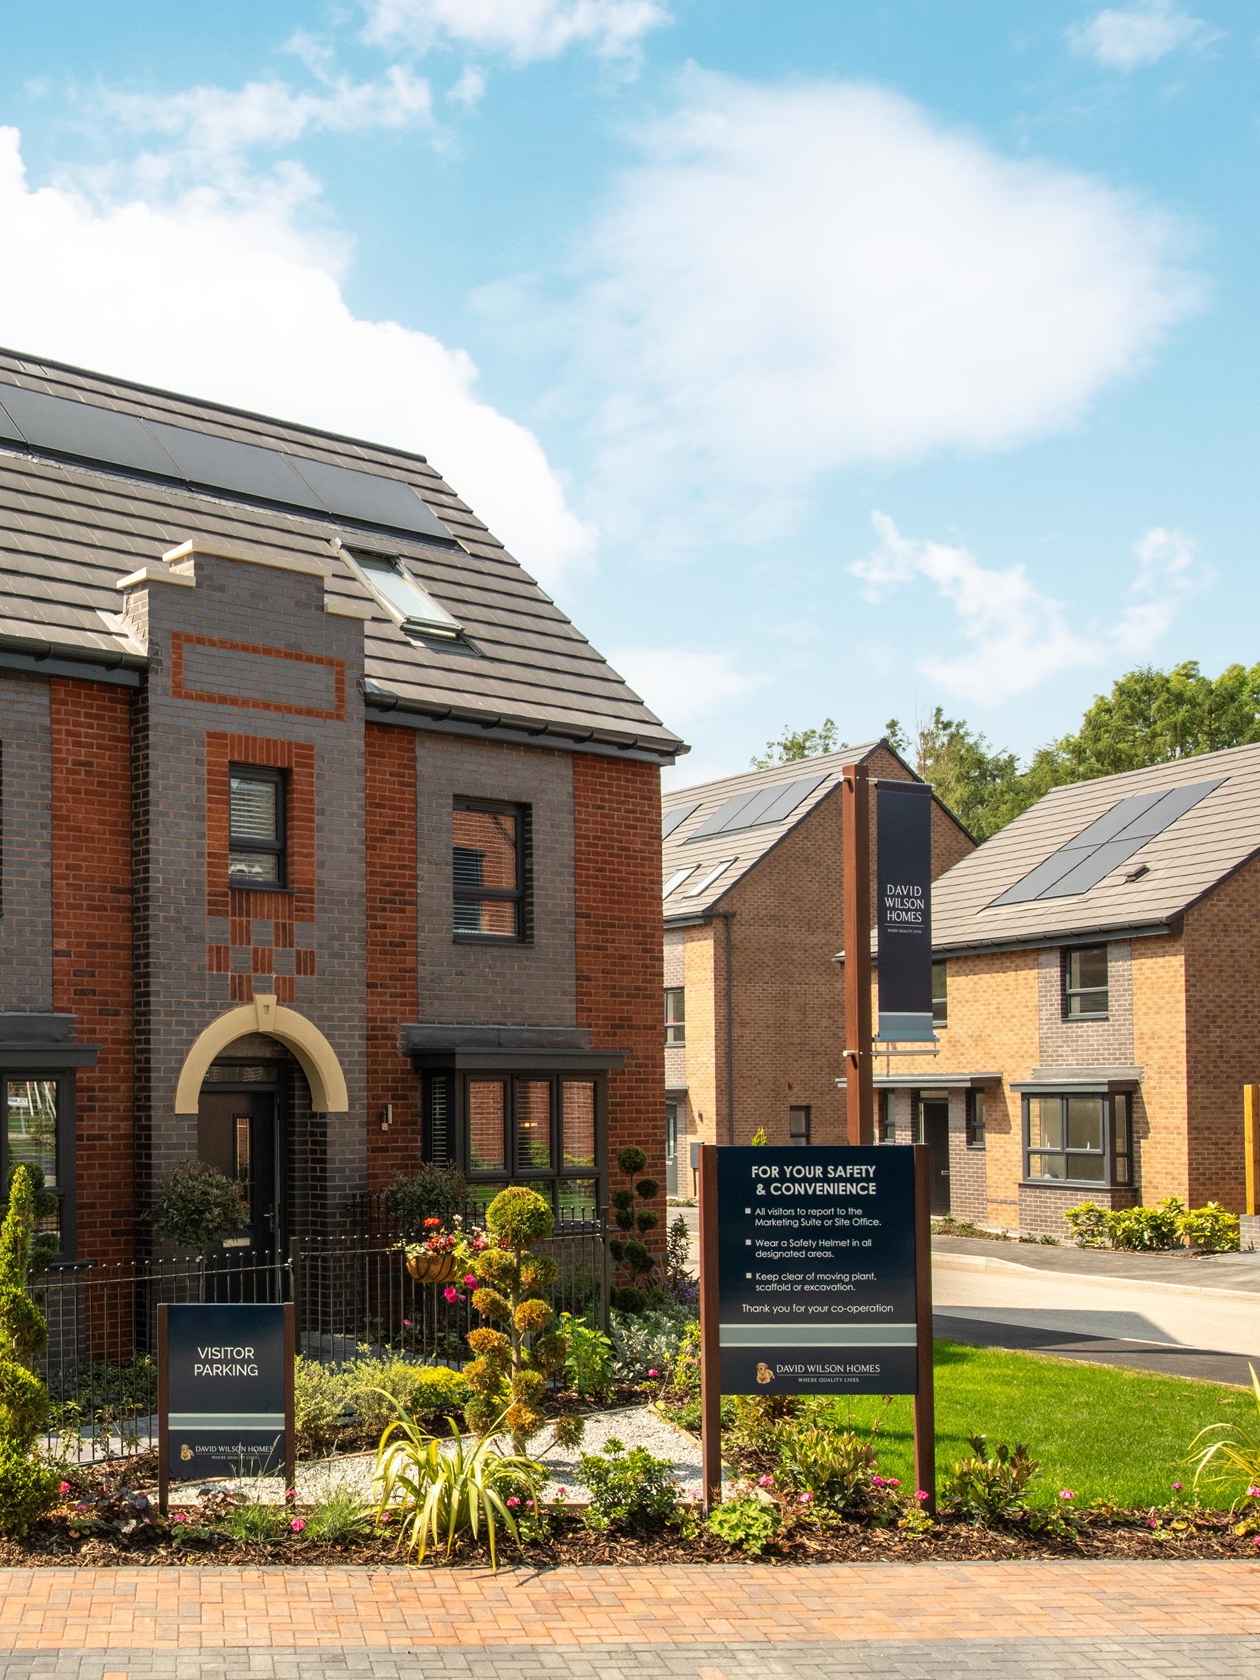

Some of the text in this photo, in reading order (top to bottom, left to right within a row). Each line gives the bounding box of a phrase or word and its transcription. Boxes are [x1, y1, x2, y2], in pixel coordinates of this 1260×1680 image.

[887, 884, 922, 896] DAVID
[884, 897, 925, 909] WILSON
[887, 910, 922, 922] HOMES
[752, 1165, 876, 1178] FOR YOUR SAFETY
[756, 1182, 877, 1195] & CONVENIENCE
[755, 1208, 863, 1218] All visitors to report to the
[755, 1218, 799, 1228] Marketing
[801, 1218, 822, 1226] Suite
[835, 1218, 850, 1226] Site
[852, 1218, 882, 1226] Office.
[755, 1239, 779, 1247] Wear
[790, 1239, 817, 1249] Safety
[819, 1239, 850, 1247] Helmet
[852, 1239, 859, 1247] in
[862, 1239, 871, 1247] all
[755, 1250, 805, 1260] designated
[756, 1272, 877, 1283] Keep clear of moving plant,
[756, 1283, 791, 1291] scaffold
[804, 1283, 856, 1291] excavation.
[742, 1304, 894, 1315] Thank you for your co-operation
[198, 1347, 255, 1359] VISITOR
[195, 1364, 258, 1376] PARKING
[777, 1364, 880, 1373] DAVID WILSON HOMES
